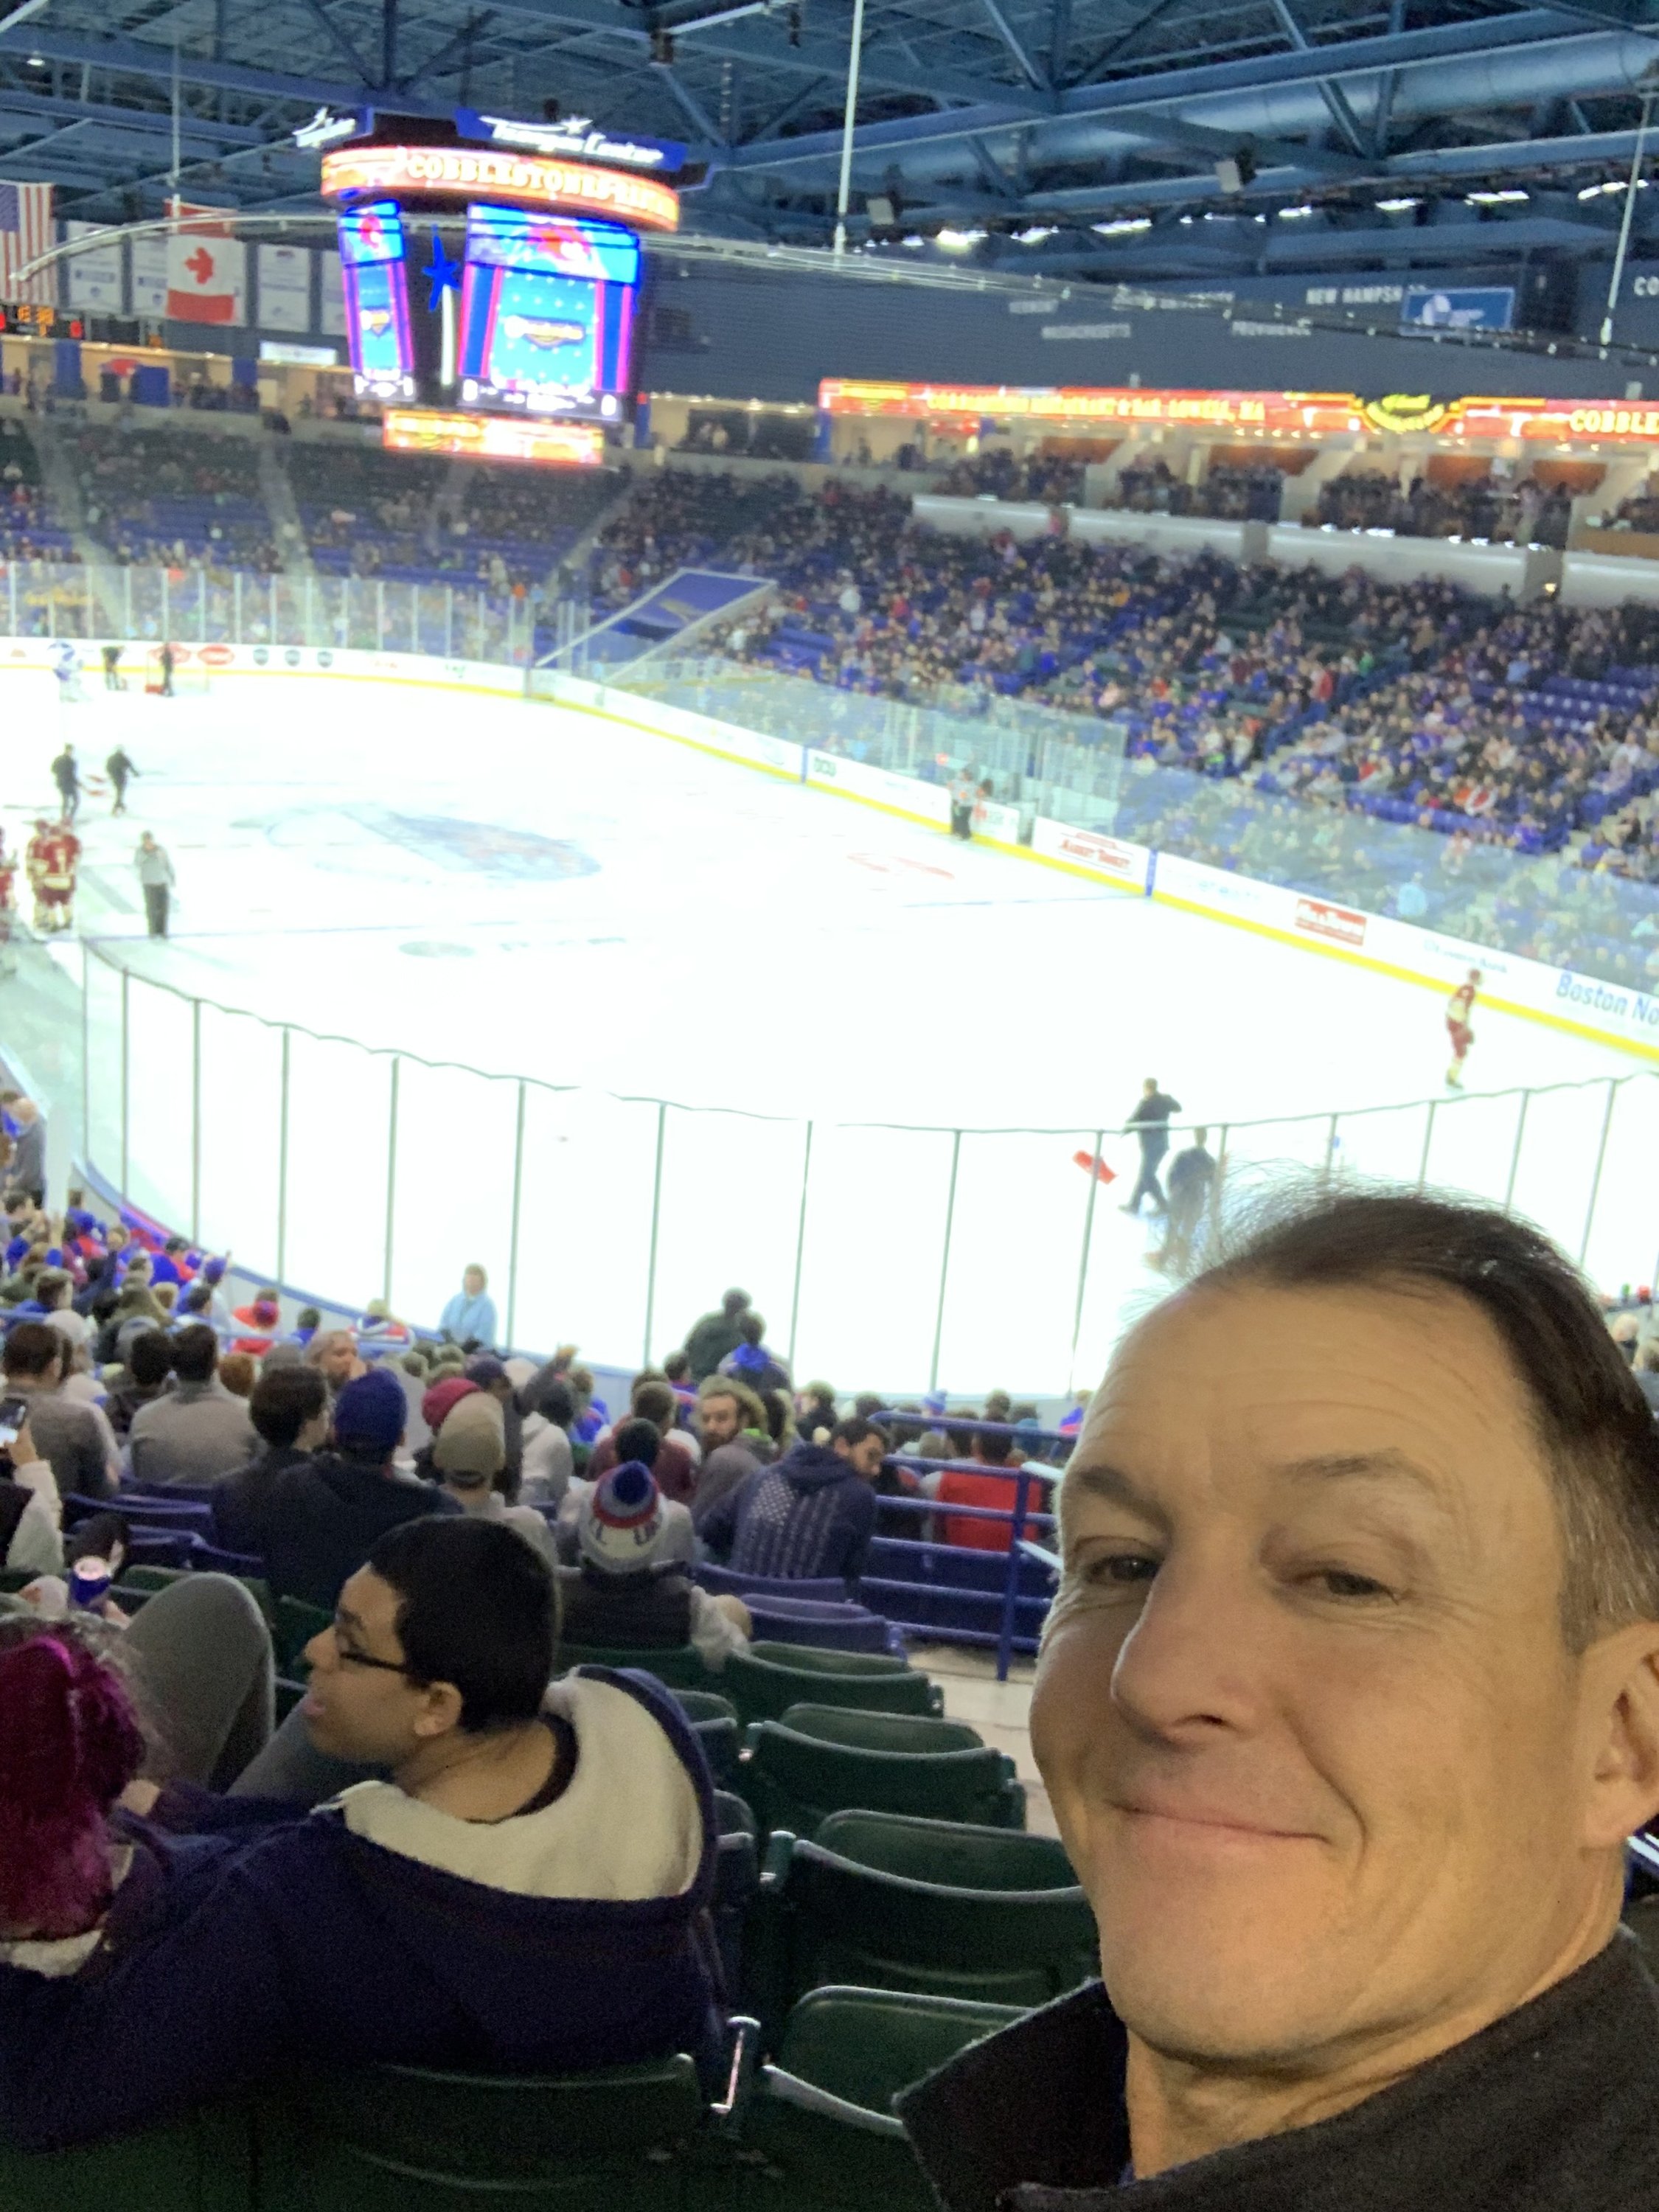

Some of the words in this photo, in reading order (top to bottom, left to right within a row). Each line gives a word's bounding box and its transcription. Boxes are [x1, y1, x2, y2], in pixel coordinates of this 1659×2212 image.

[583, 133, 663, 163] Center
[1306, 288, 1338, 305] NEW
[1556, 971, 1628, 1017] Boston
